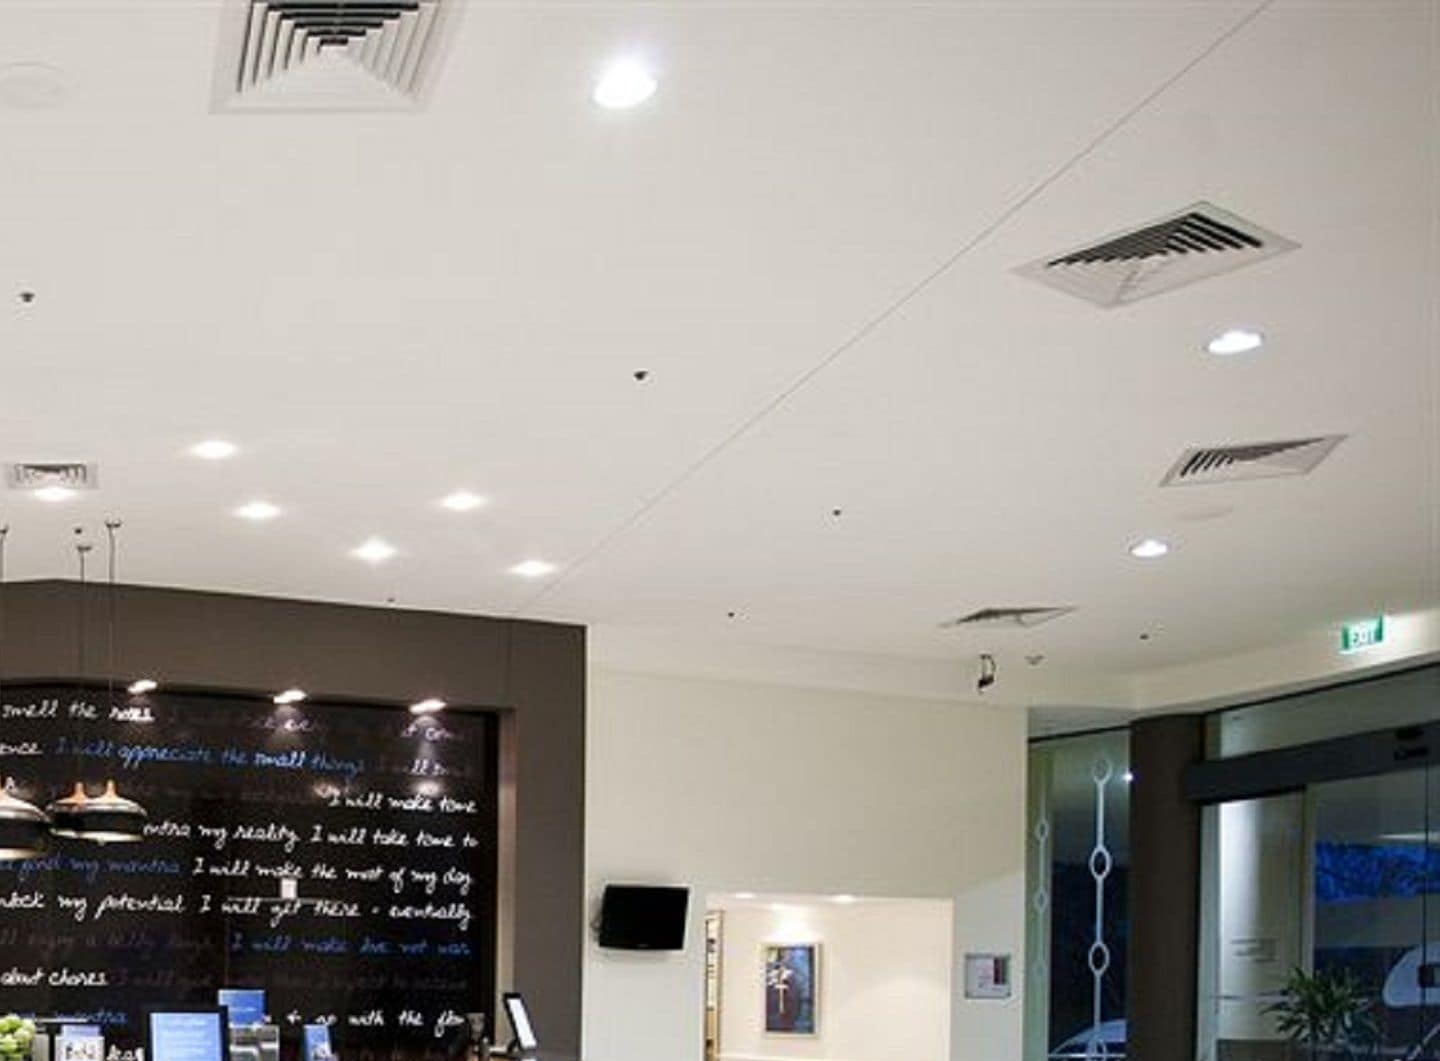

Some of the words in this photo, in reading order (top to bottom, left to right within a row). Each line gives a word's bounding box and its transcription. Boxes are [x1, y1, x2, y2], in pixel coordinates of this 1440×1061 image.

[1, 698, 60, 719] smell
[68, 698, 99, 720] the
[117, 743, 212, 770] appreciate
[220, 745, 248, 766] the
[253, 749, 308, 770] small
[344, 792, 383, 812] will
[389, 793, 435, 813] make
[438, 796, 480, 815] time
[196, 824, 229, 852] my
[309, 823, 324, 845] I
[326, 826, 369, 847] will
[372, 827, 409, 848] take
[415, 829, 457, 849] time
[462, 830, 480, 849] to
[69, 858, 100, 883] my
[191, 856, 206, 877] I
[208, 858, 251, 878] will
[254, 860, 304, 879] make
[310, 862, 339, 880] the
[344, 864, 386, 881] most
[387, 865, 406, 895] of
[409, 868, 438, 896] my
[442, 865, 474, 897] day
[56, 893, 88, 922] my
[93, 892, 185, 920] potential
[199, 892, 213, 914] I
[220, 896, 261, 915] will
[269, 900, 303, 928] get
[311, 900, 361, 918] there
[387, 901, 474, 932] eventually
[231, 931, 244, 952] I
[250, 933, 292, 954] will
[299, 935, 350, 955] make
[0, 964, 46, 987] about
[347, 1009, 386, 1027] with
[397, 1009, 425, 1027] the
